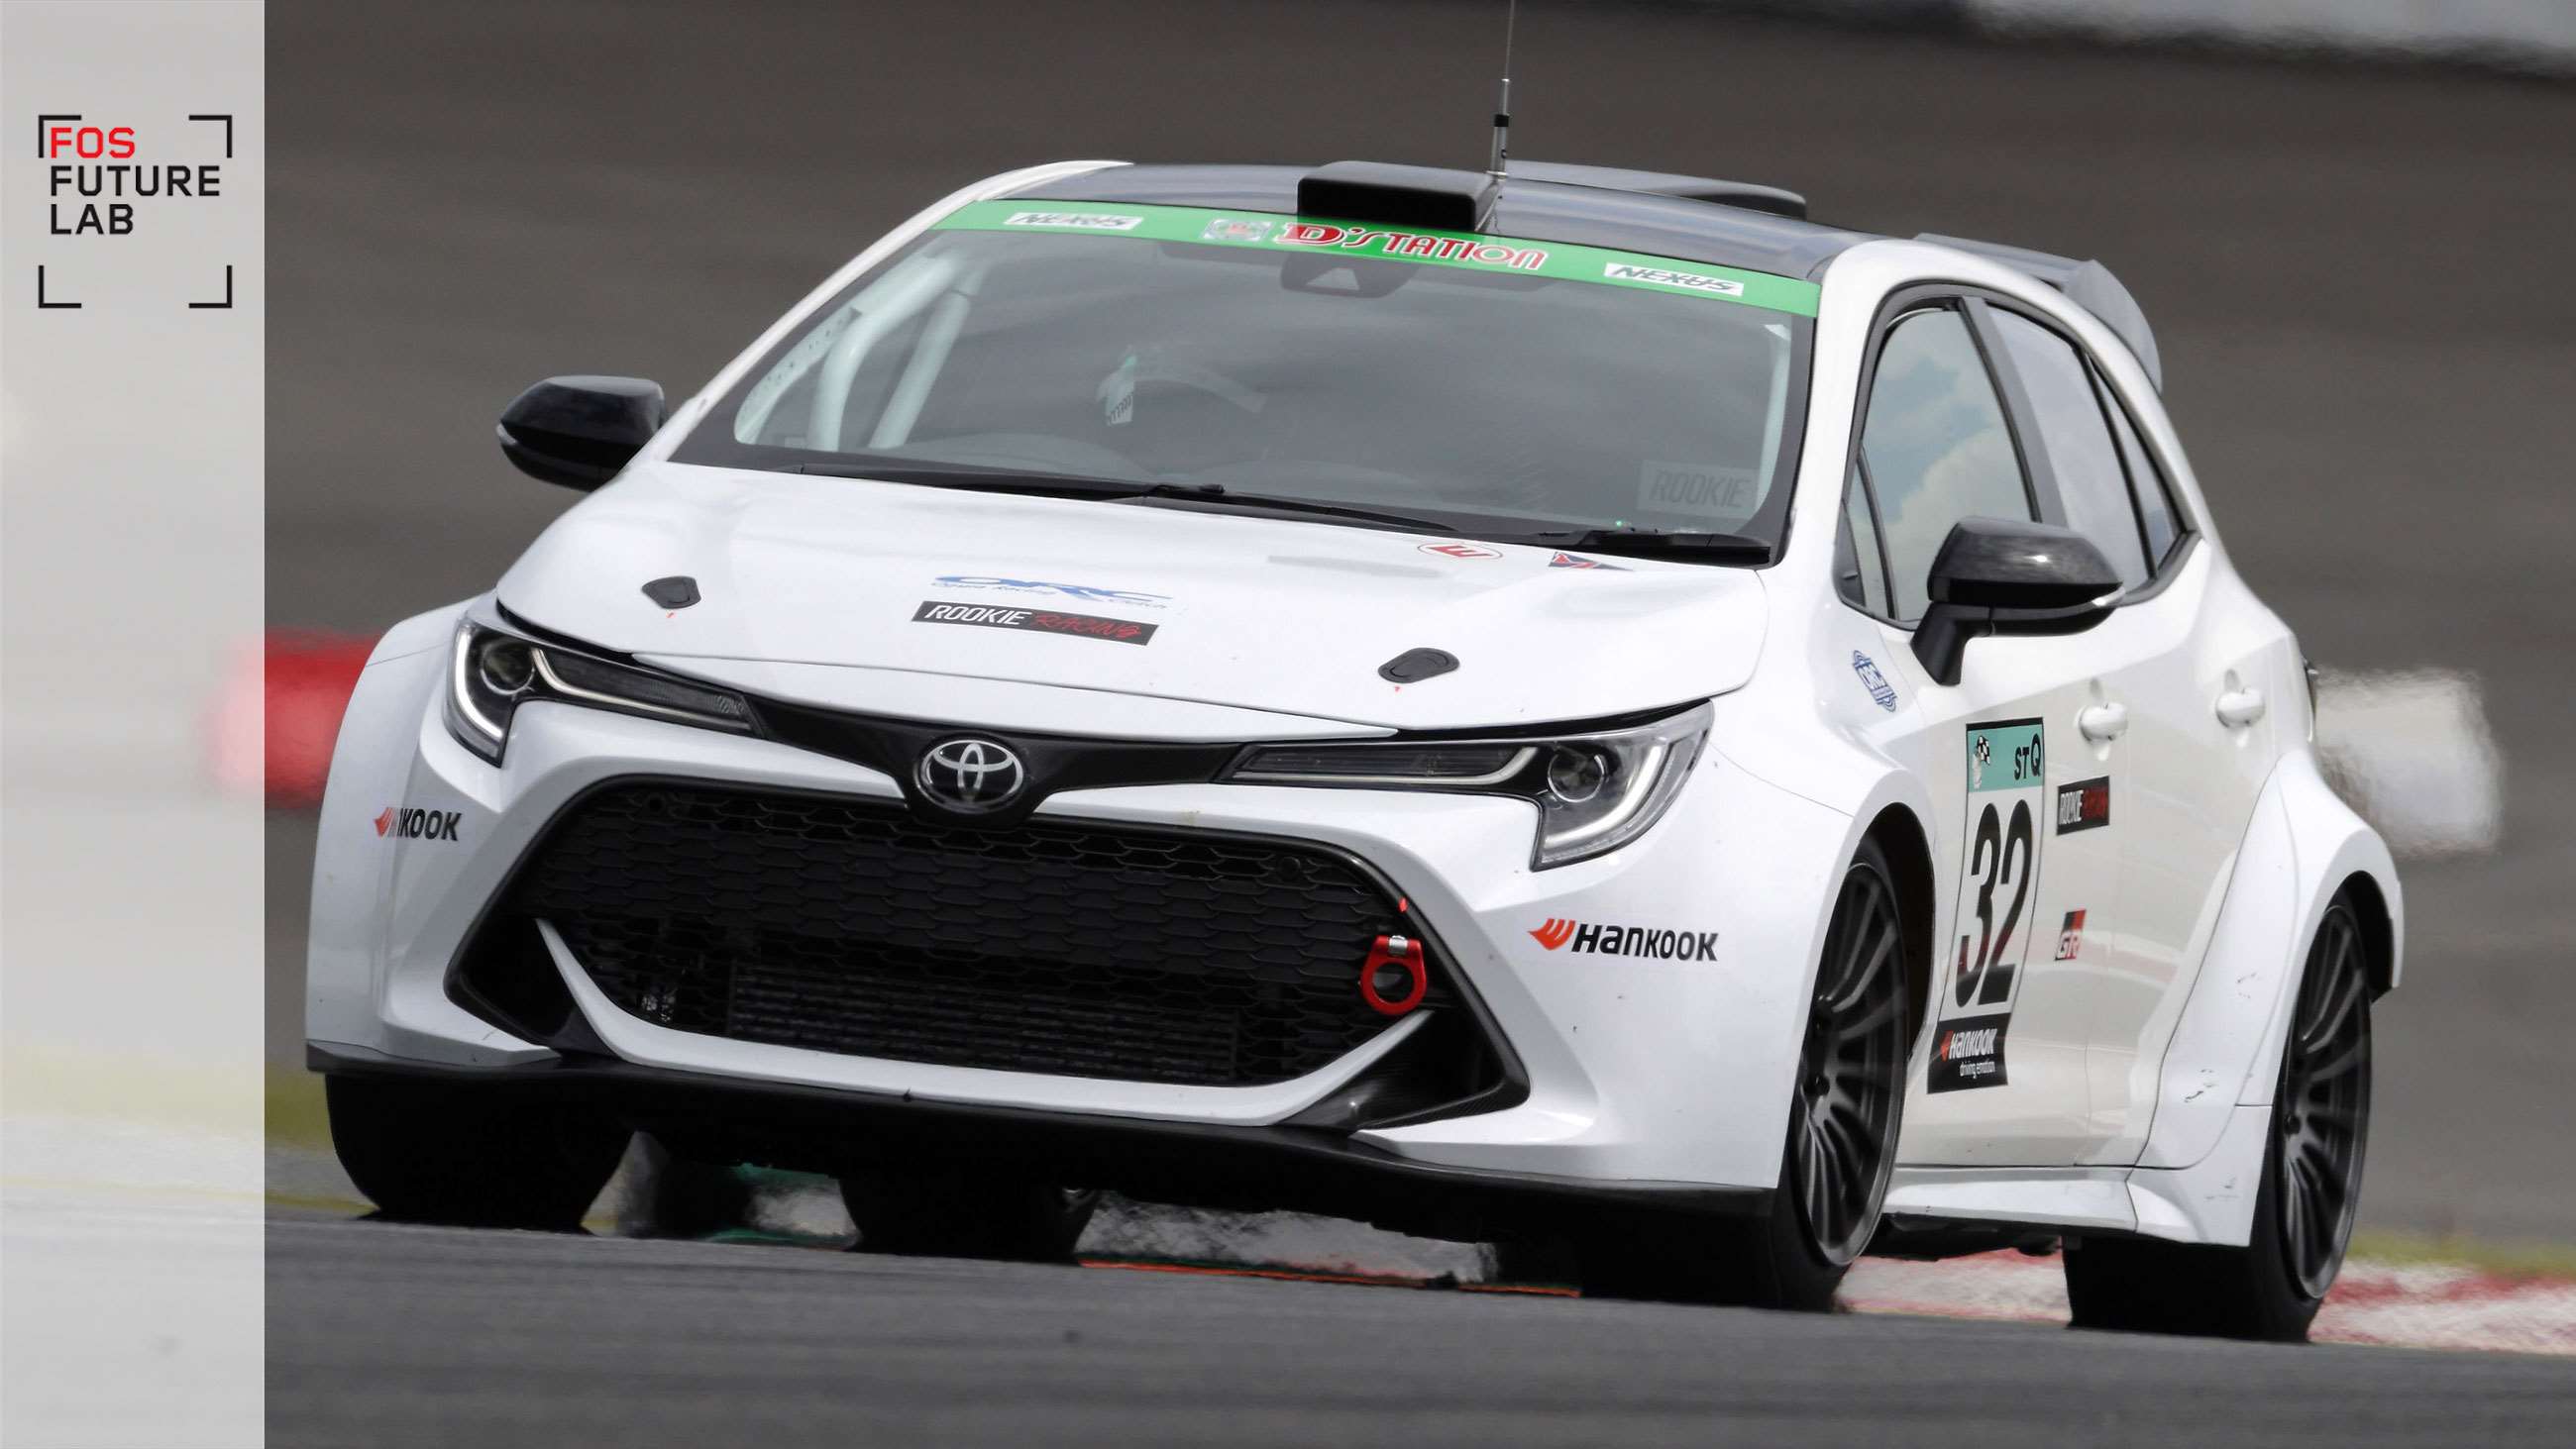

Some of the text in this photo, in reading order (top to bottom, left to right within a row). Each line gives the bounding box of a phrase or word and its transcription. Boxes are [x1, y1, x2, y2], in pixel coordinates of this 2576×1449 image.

[1611, 265, 1737, 291] NEXUS
[1649, 468, 1751, 508] ROOKIE
[924, 604, 1032, 626] ROOKIE
[1955, 799, 2033, 1009] 32
